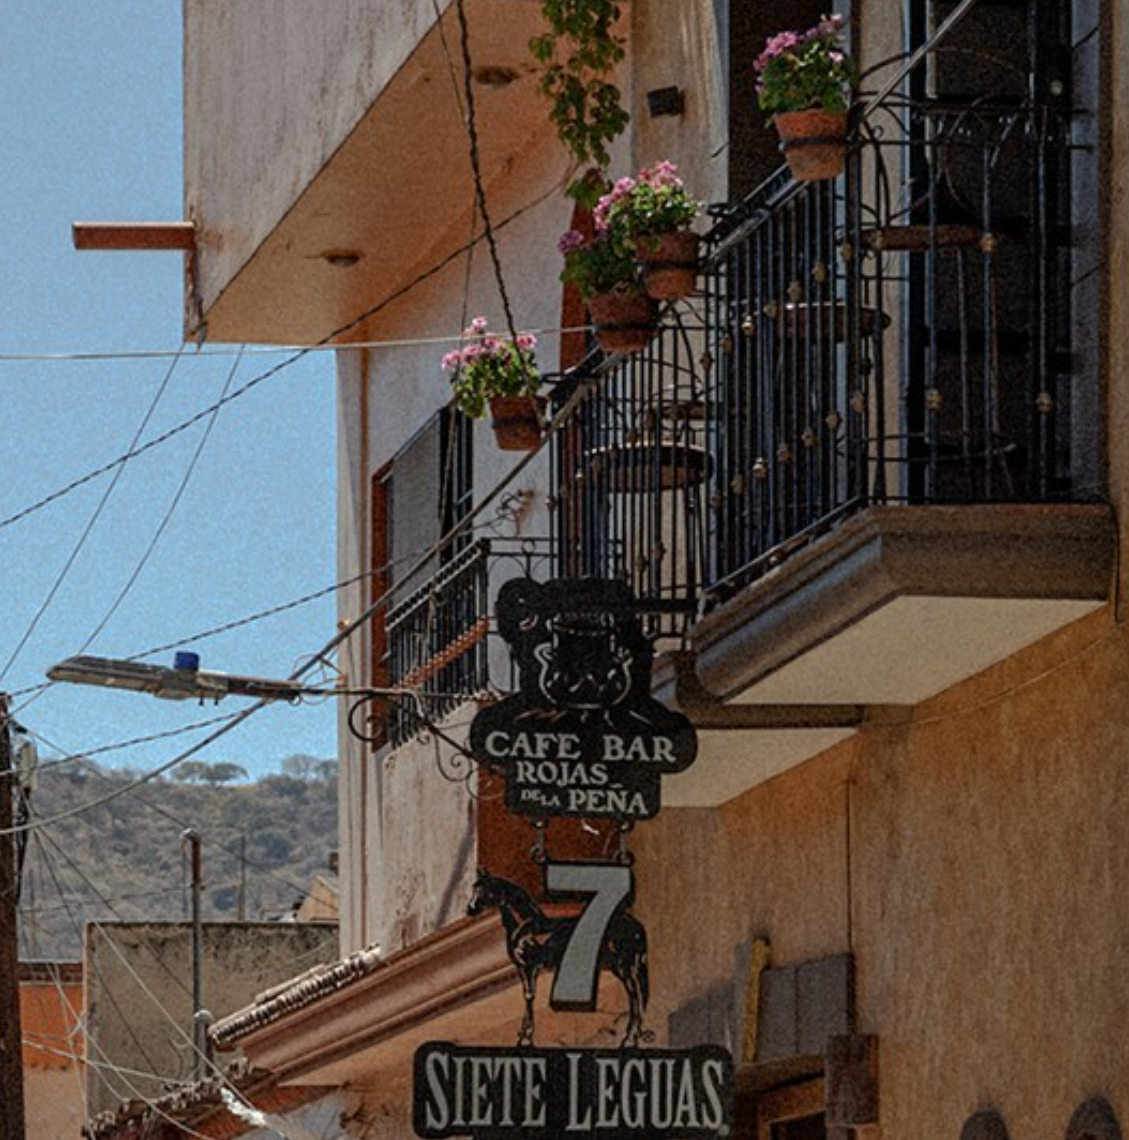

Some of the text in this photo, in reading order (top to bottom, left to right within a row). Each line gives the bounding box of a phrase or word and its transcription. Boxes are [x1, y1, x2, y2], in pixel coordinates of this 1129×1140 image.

[485, 731, 677, 762] CAFE BAR
[516, 761, 608, 787] ROJAS
[521, 783, 649, 814] DE LA PEÑA
[546, 865, 631, 1002] 7
[425, 1051, 725, 1132] SIETE LEGUAS
